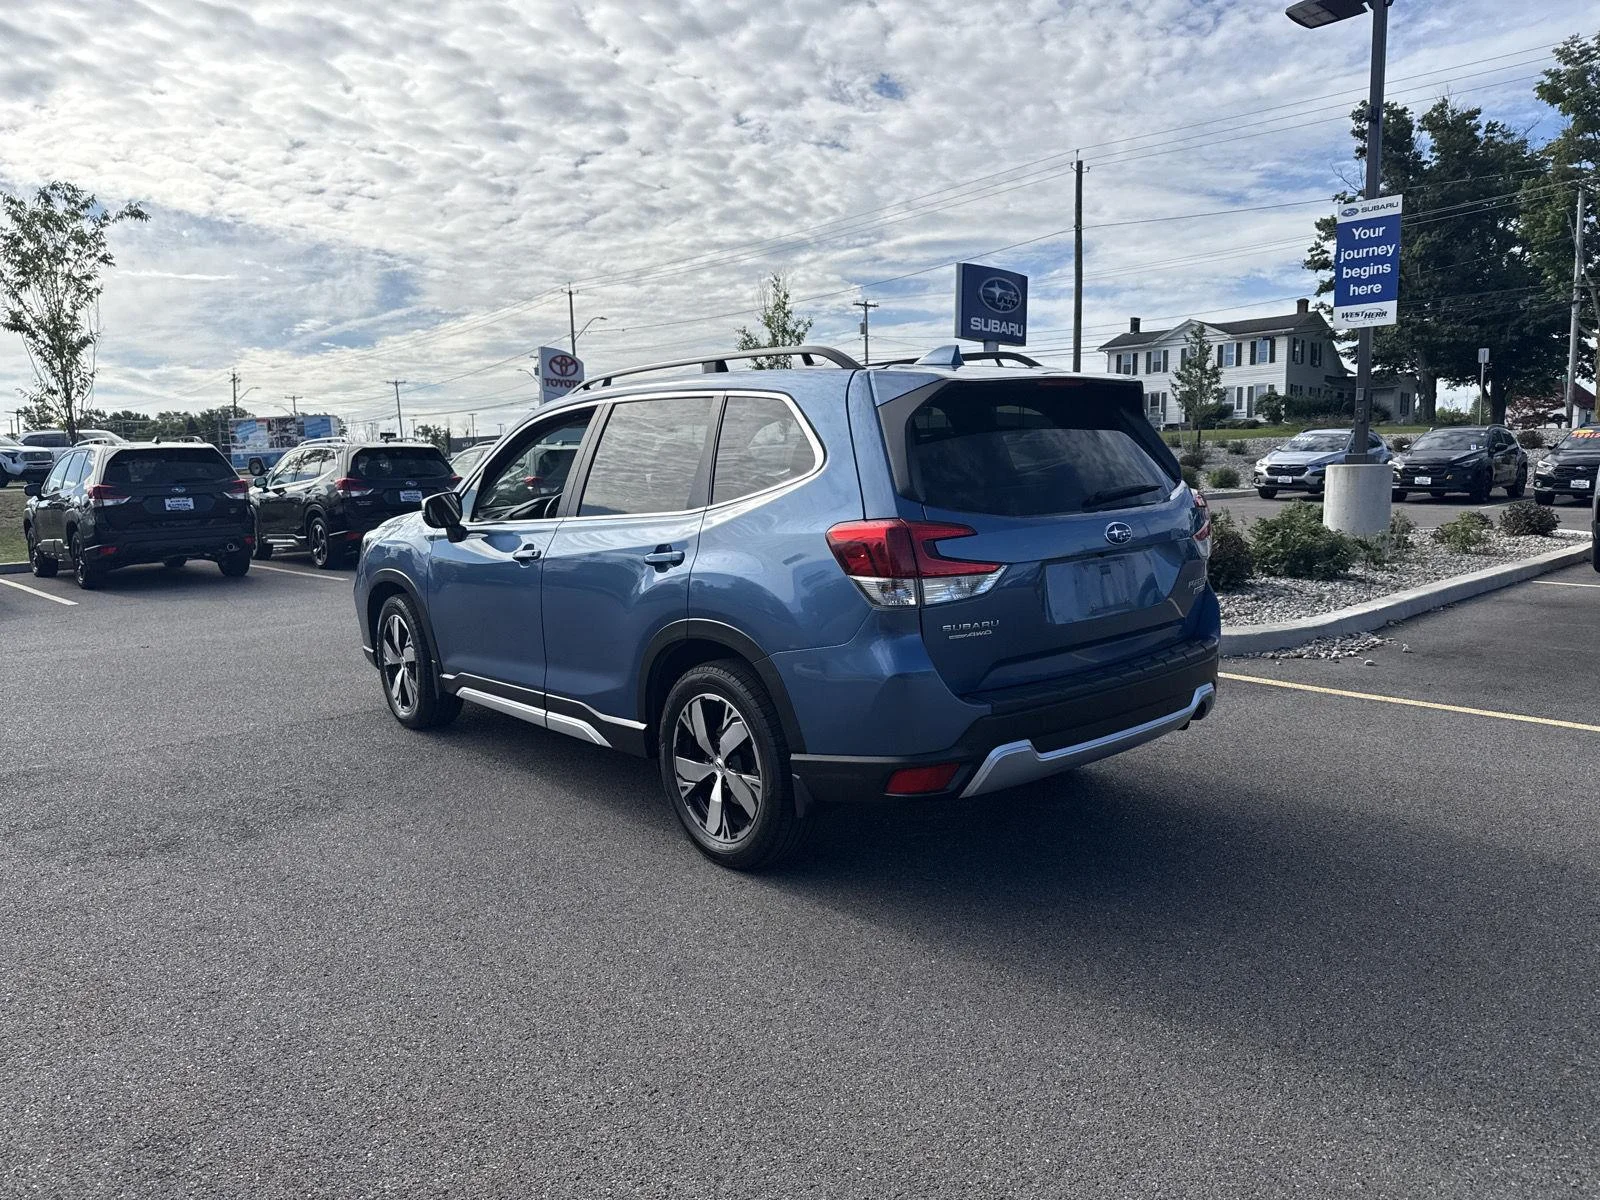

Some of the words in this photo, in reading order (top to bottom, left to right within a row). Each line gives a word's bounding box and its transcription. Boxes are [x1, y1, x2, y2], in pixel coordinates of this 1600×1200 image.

[1361, 202, 1398, 213] SUBARU
[1352, 226, 1386, 240] Your
[1339, 244, 1396, 263] journey
[1342, 263, 1392, 279] begins
[1350, 283, 1382, 296] here
[970, 316, 1023, 337] SUBARU
[942, 619, 1000, 632] SUBARU
